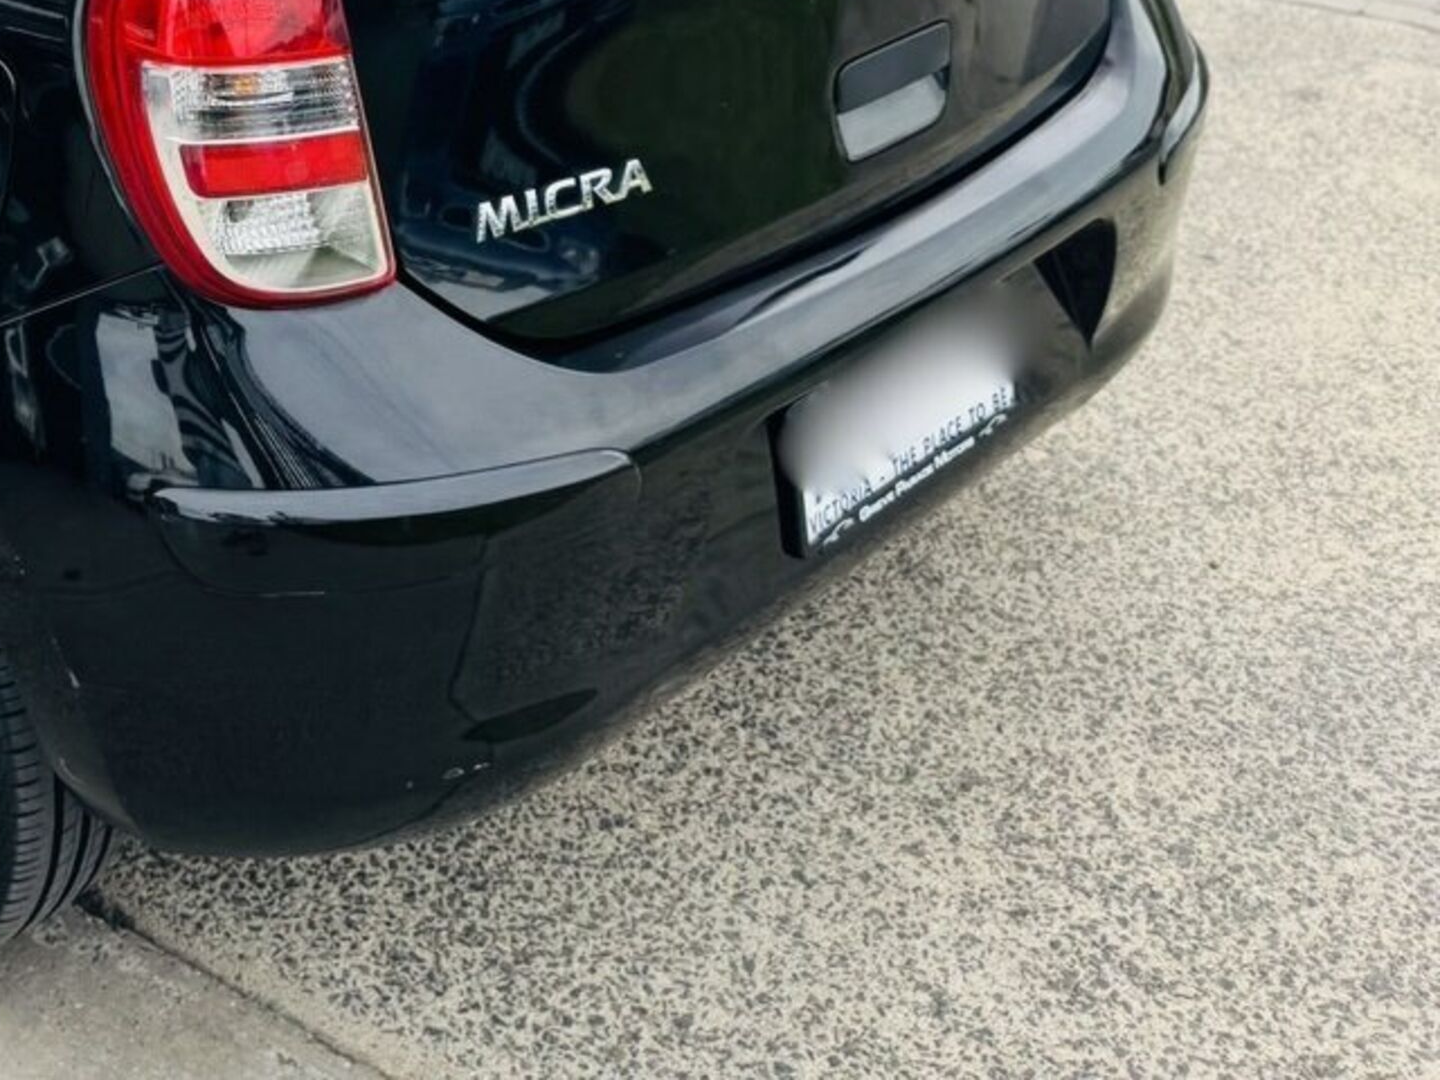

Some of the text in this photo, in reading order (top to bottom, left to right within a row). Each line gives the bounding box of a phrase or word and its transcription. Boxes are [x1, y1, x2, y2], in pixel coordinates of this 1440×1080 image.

[476, 158, 653, 244] MICRA
[809, 476, 873, 536] VICTORIA
[890, 446, 918, 476] THE
[922, 416, 963, 458] PLACE
[968, 402, 986, 425] TO
[992, 386, 1007, 414] BE
